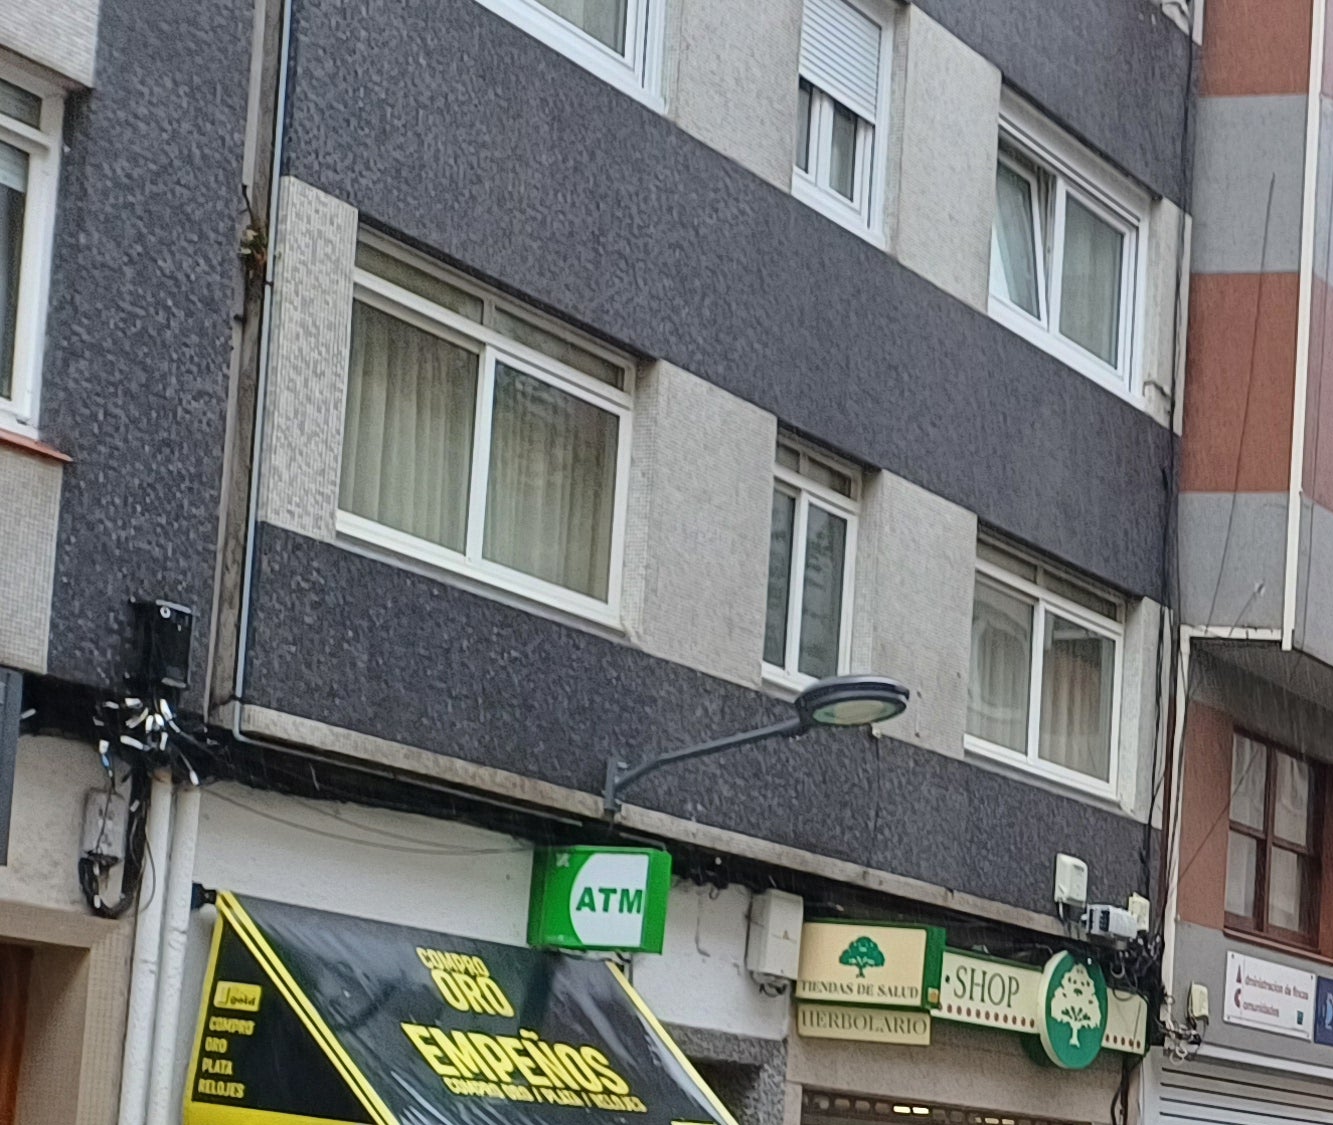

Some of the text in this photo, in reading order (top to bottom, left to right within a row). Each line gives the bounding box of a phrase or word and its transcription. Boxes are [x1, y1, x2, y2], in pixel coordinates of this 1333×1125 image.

[576, 885, 643, 916] ATM
[416, 946, 490, 977] COMPRO
[431, 970, 515, 1018] ORO
[801, 980, 919, 999] TIENDAS DE SALUD
[953, 966, 1020, 1008] SHOP
[209, 1016, 255, 1035] COMPRO
[802, 1010, 927, 1036] HERBOLARIO
[205, 1037, 228, 1053] ORO
[400, 1021, 630, 1095] EMPEÑOS
[202, 1058, 233, 1075] PLATA
[198, 1078, 245, 1098] RELOJES
